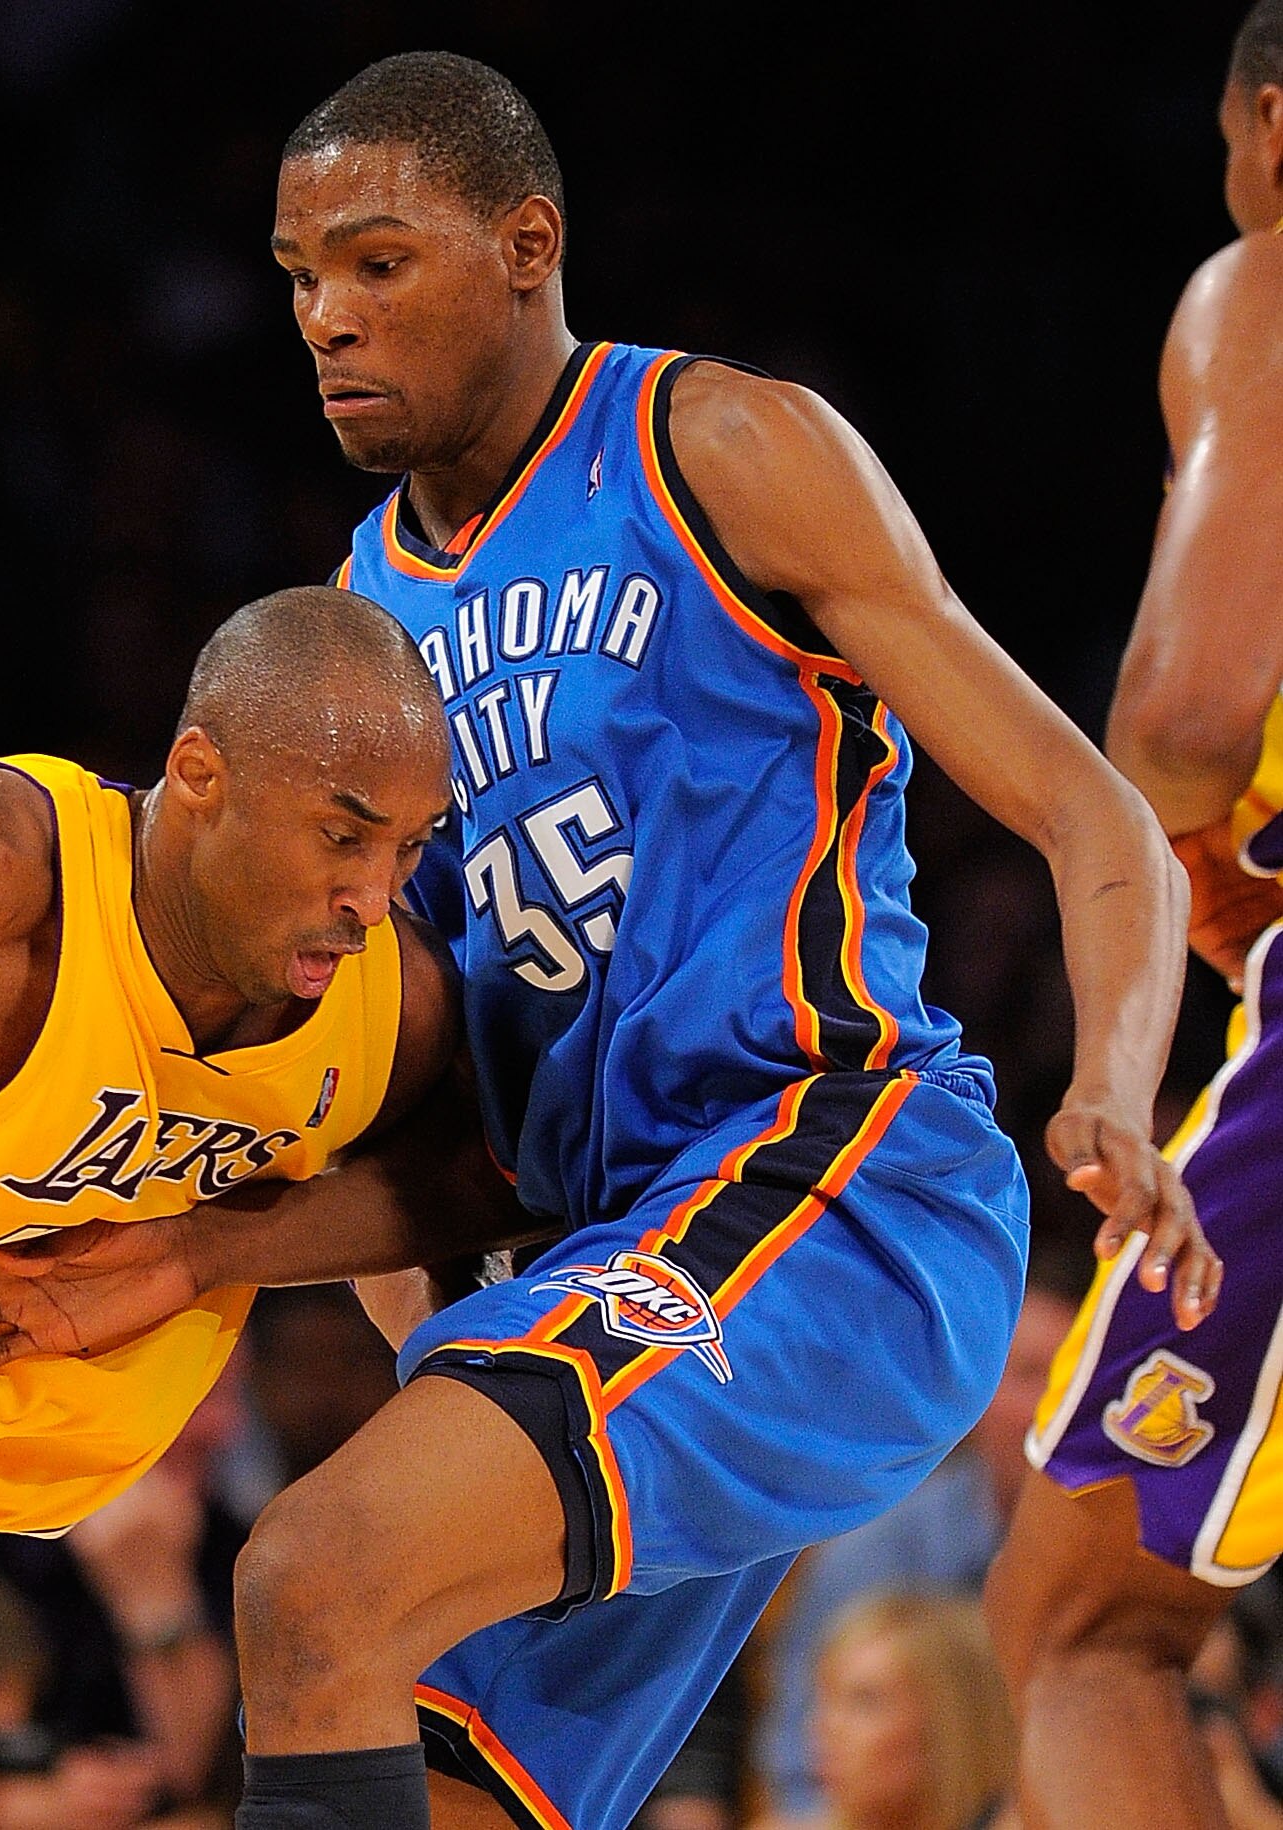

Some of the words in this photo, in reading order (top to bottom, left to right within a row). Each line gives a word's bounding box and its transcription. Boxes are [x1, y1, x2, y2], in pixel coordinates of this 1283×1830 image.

[418, 565, 664, 704] AHOMA
[461, 774, 636, 993] 35
[571, 1268, 700, 1324] OKC
